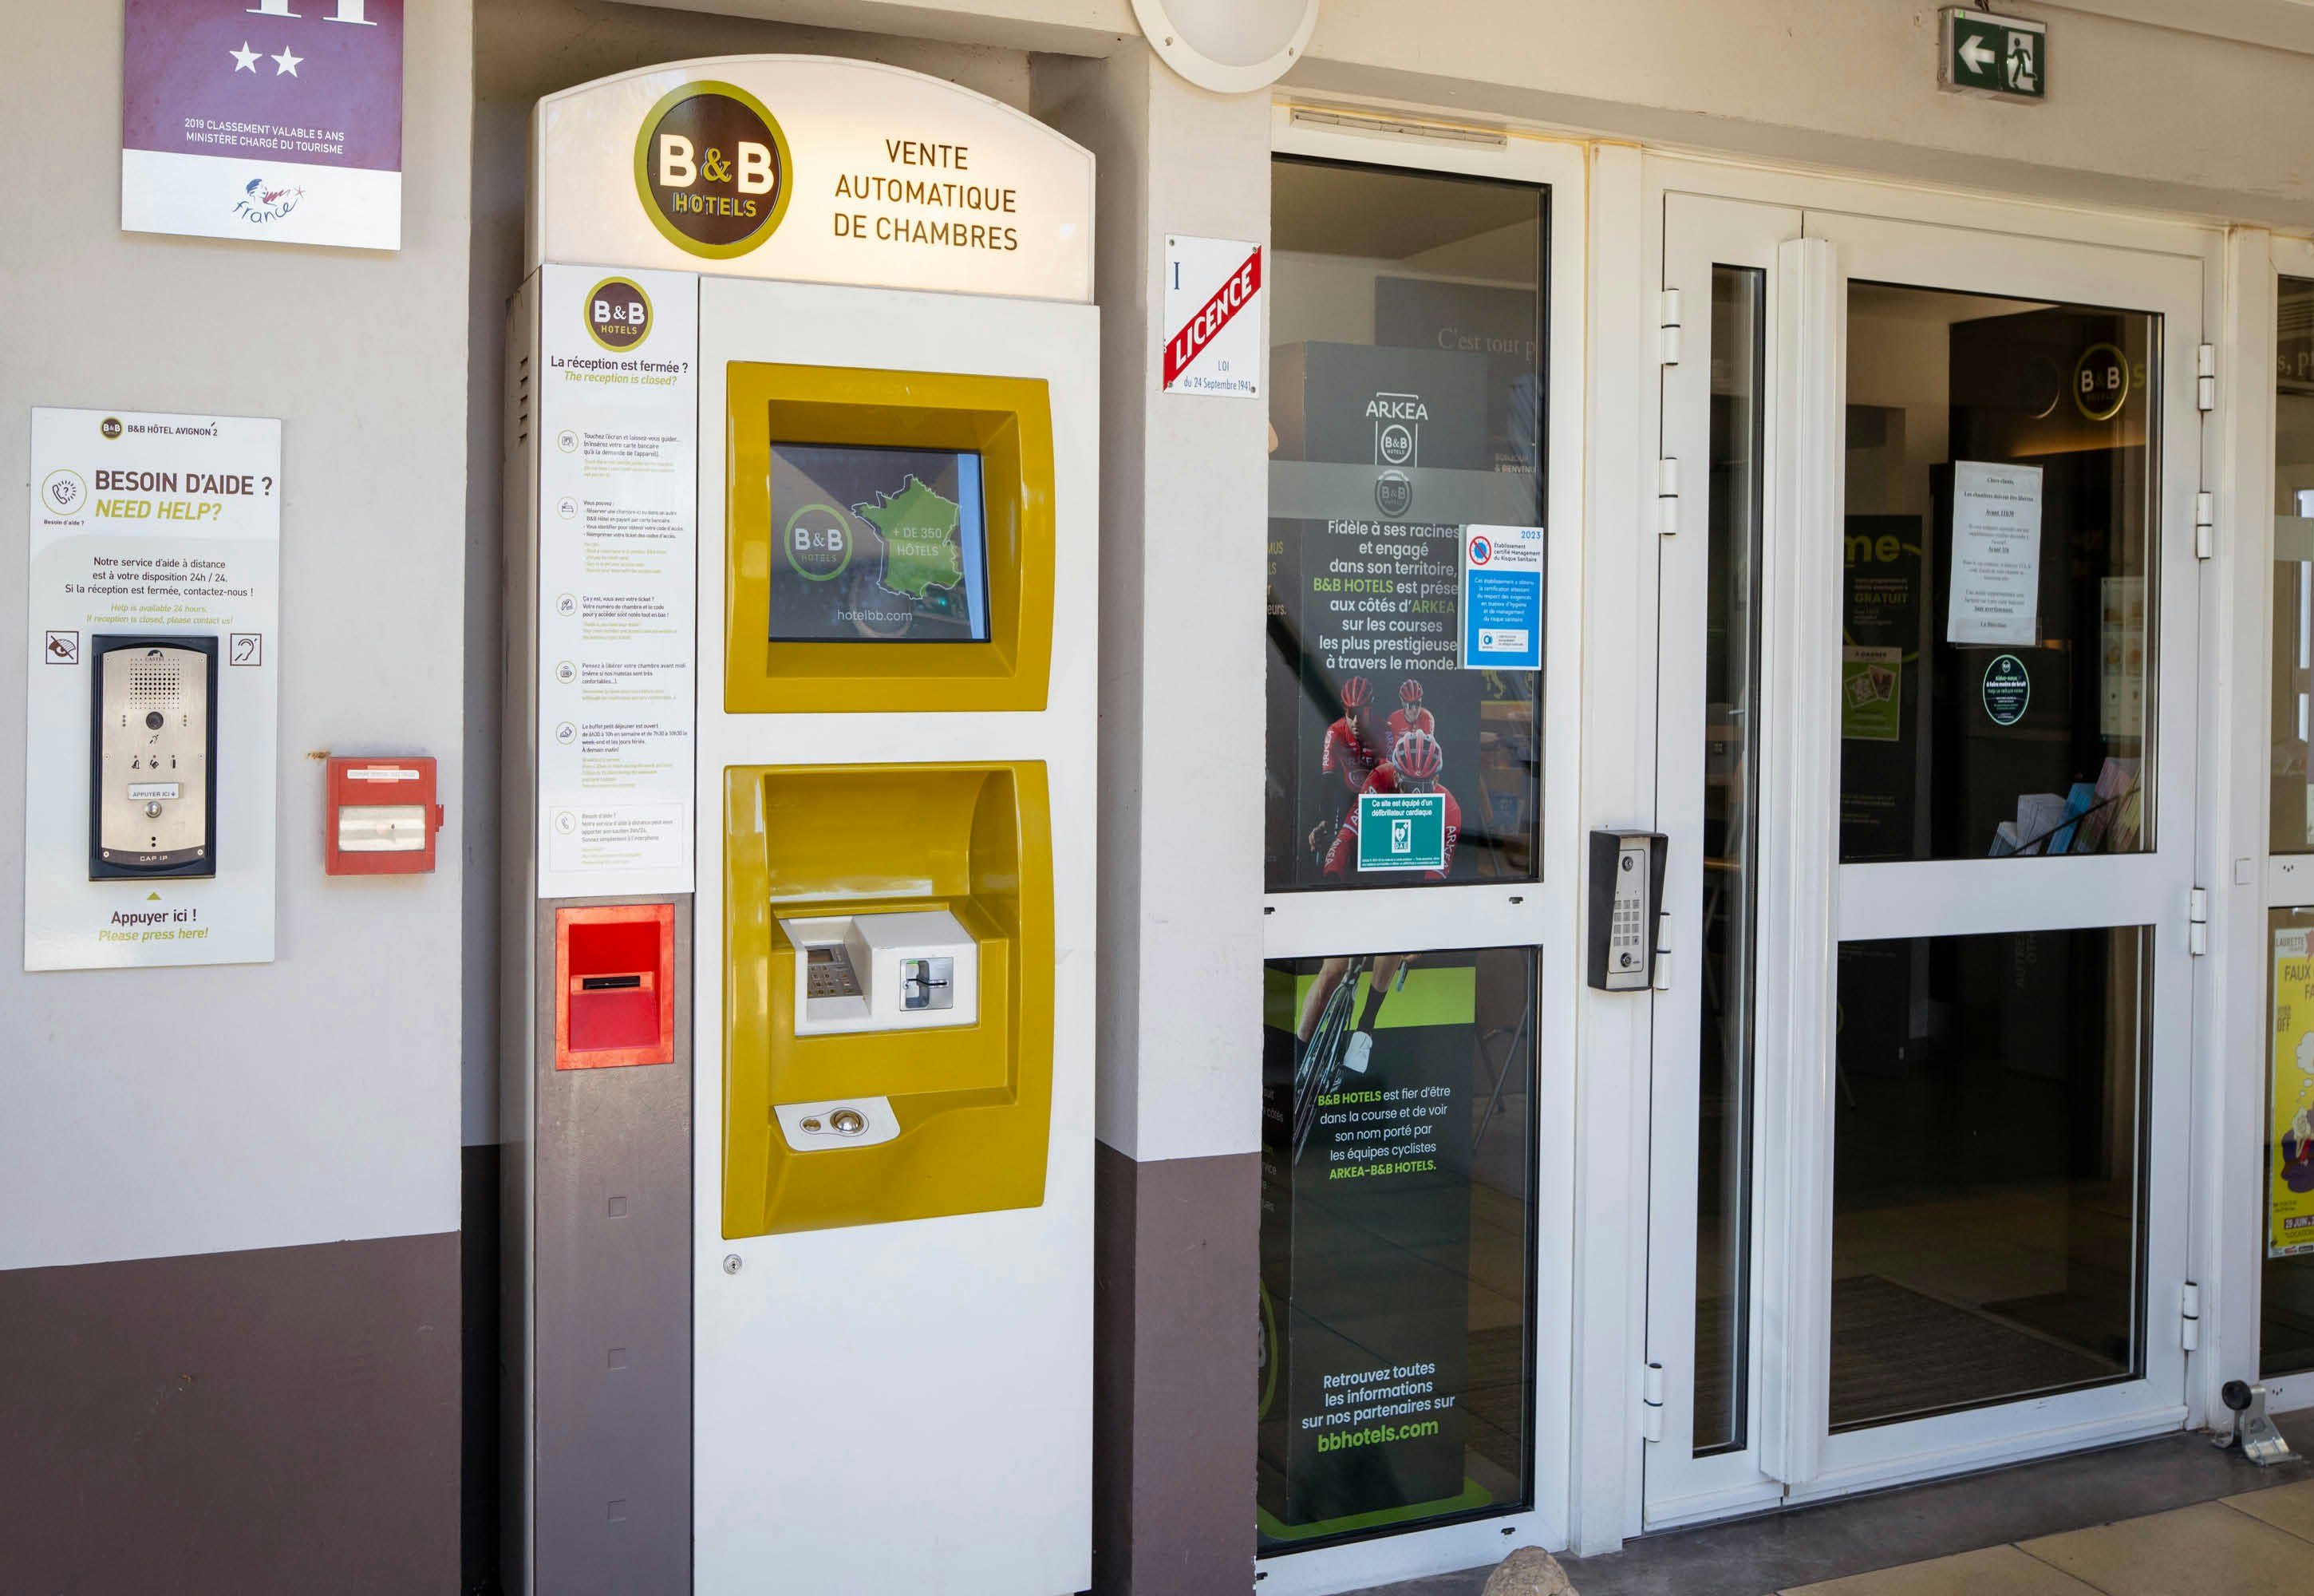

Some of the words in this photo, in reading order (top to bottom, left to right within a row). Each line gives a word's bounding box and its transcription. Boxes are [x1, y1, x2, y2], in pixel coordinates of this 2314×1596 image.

[184, 118, 204, 128] 2019
[207, 120, 270, 135] CLASSEMENT
[272, 127, 315, 139] VALABLE
[325, 132, 345, 141] ANS
[186, 132, 238, 145] MINISTÈRE
[239, 136, 278, 149] CHARGÉ
[280, 141, 294, 150] DU
[296, 142, 343, 154] TOURISME
[886, 139, 968, 170] VENTE
[660, 133, 774, 196] B&B
[835, 174, 1017, 213] AUTOMATIQUE
[674, 192, 757, 219] HOTELS
[835, 213, 867, 239] DE
[876, 217, 1018, 251] CHAMBRES
[594, 300, 645, 325] B&B
[1176, 263, 1252, 370] LICENCE
[601, 325, 638, 335] HOTELS
[551, 356, 564, 368] La
[567, 356, 618, 372] réception
[621, 361, 638, 371] est
[640, 360, 680, 373] fermée
[1218, 360, 1230, 371] LOI
[564, 370, 582, 381] The
[584, 373, 629, 385] reception
[631, 375, 638, 385] is
[641, 375, 677, 385] closed?
[1184, 376, 1192, 388] du
[1194, 377, 1202, 389] 24
[1203, 379, 1237, 391] Septembre
[1238, 380, 1251, 391] 1941
[1365, 400, 1428, 421] ARKEA
[128, 425, 145, 433] B&B
[147, 425, 173, 435] HÔTEL
[176, 427, 211, 437] AVIGNON
[1384, 437, 1408, 448] B&B
[95, 469, 177, 493] BESOIN
[186, 473, 254, 496] D'AIDE
[95, 499, 151, 519] NEED
[156, 501, 223, 520] HELP?
[903, 528, 919, 538] DE
[922, 528, 942, 539] 350
[1328, 520, 1368, 536] Fidèle
[1372, 521, 1380, 536] à
[1384, 525, 1406, 537] ses
[1409, 523, 1459, 539] racines
[1521, 530, 1541, 539] 2023
[795, 528, 843, 551] B&B
[897, 543, 938, 556] HÔTELS
[1359, 543, 1372, 555] et
[1376, 542, 1428, 560] engagé
[93, 557, 119, 567] Notre
[121, 559, 153, 567] service
[156, 557, 180, 568] d'aide
[182, 558, 188, 568] à
[190, 559, 226, 569] distance
[1329, 560, 1364, 574] dans
[1367, 563, 1392, 575] son
[1395, 560, 1458, 579] territoire,
[109, 571, 114, 580] à
[141, 572, 188, 584] disposition
[190, 573, 206, 582] 24h
[65, 584, 73, 594] Si
[77, 584, 85, 594] la
[88, 584, 128, 597] réception
[147, 585, 181, 597] fermée,
[184, 587, 247, 597] contactez-nous
[1313, 577, 1341, 592] B&B
[1344, 578, 1393, 594] HOTELS
[1396, 582, 1418, 595] est
[1420, 579, 1459, 598] prése
[1330, 600, 1356, 612] aux
[1358, 598, 1396, 613] côtés
[837, 610, 913, 622] hotelbb.com
[1342, 619, 1364, 632] sur
[1367, 617, 1386, 632] les
[1388, 620, 1443, 633] courses
[1319, 635, 1338, 649] les
[1341, 635, 1370, 654] plus
[1373, 636, 1459, 655] prestigieuse
[1326, 654, 1336, 668] à
[1338, 655, 1387, 670] travers
[1390, 655, 1402, 670] le
[1404, 655, 1458, 671] monde.
[1401, 799, 1420, 808] équipé
[111, 911, 169, 926] Appuyer
[172, 910, 188, 923] ici
[98, 930, 140, 942] Please
[141, 930, 176, 943] press
[178, 926, 209, 940] here!
[2284, 965, 2311, 982] FAUX
[1318, 1094, 1341, 1107] B&B
[1342, 1090, 1381, 1104] HOTELS
[1384, 1091, 1399, 1101] est
[1402, 1088, 1418, 1100] fier
[1420, 1086, 1451, 1098] d'être
[1320, 1112, 1347, 1124] dans
[1349, 1111, 1359, 1122] la
[1361, 1109, 1397, 1121] course
[1400, 1108, 1411, 1118] et
[1412, 1105, 1426, 1117] de
[1428, 1104, 1448, 1116] voir
[1335, 1132, 1354, 1142] son
[1356, 1128, 1381, 1140] nom
[1383, 1124, 1412, 1141] porté
[1414, 1124, 1433, 1140] par
[1330, 1149, 1345, 1161] les
[1347, 1145, 1390, 1162] équipes
[1392, 1141, 1437, 1159] cyclistes
[1329, 1163, 1393, 1180] ARKEA-B&B
[1395, 1159, 1437, 1173] HOTELS.
[1324, 1369, 1390, 1389] Retrouvez
[1393, 1362, 1435, 1378] toutes
[1325, 1393, 1345, 1407] les
[1347, 1381, 1433, 1404] informations
[1301, 1415, 1324, 1429] sur
[1326, 1412, 1351, 1425] nos
[1354, 1398, 1431, 1426] partenaires
[1434, 1395, 1455, 1409] sur
[1317, 1420, 1439, 1453] bbhotels.com
